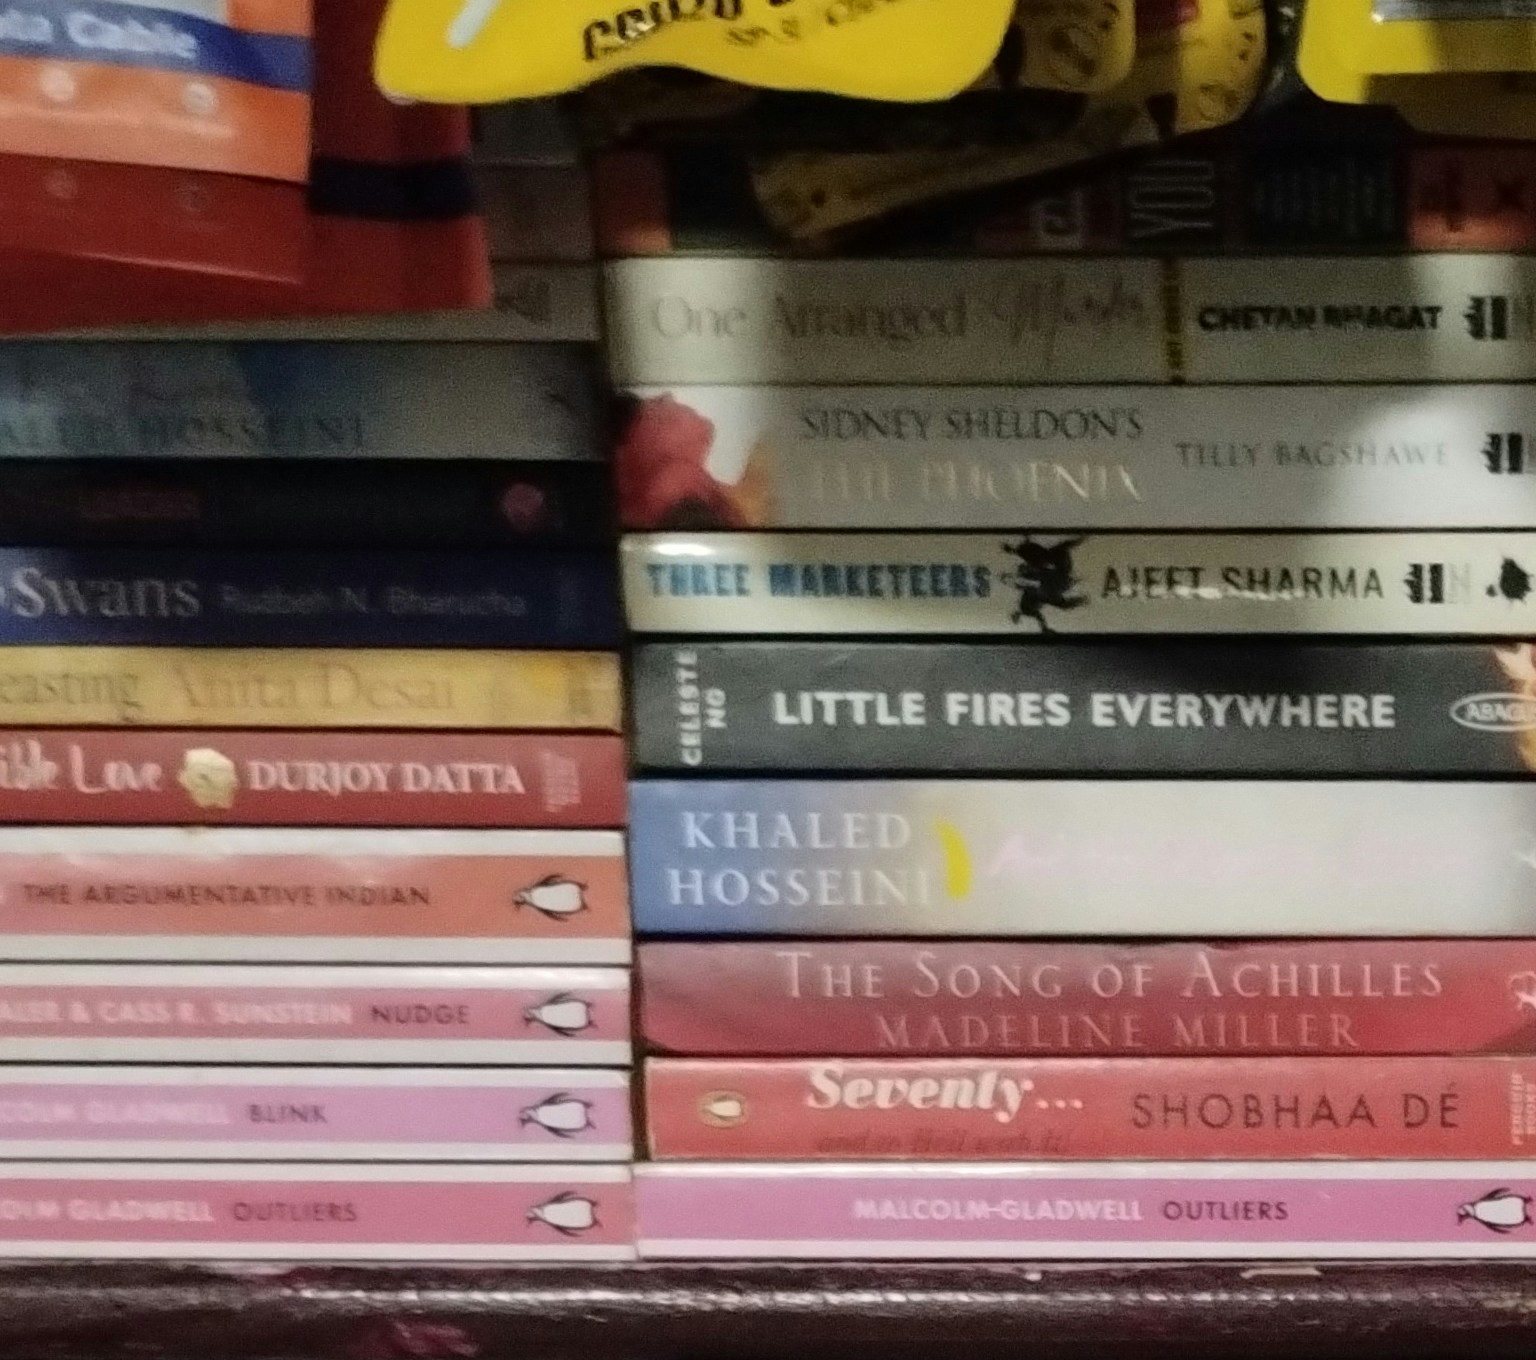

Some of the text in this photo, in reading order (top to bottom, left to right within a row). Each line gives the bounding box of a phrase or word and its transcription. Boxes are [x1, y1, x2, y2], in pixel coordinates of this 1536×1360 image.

[773, 692, 1395, 730] LITTLE FIRES EVERYWHERE
[250, 761, 525, 797] DURJOY DATTA
[680, 811, 911, 850] KHALED
[668, 869, 932, 908] HOSSEINI
[371, 1004, 468, 1024] NUDGE
